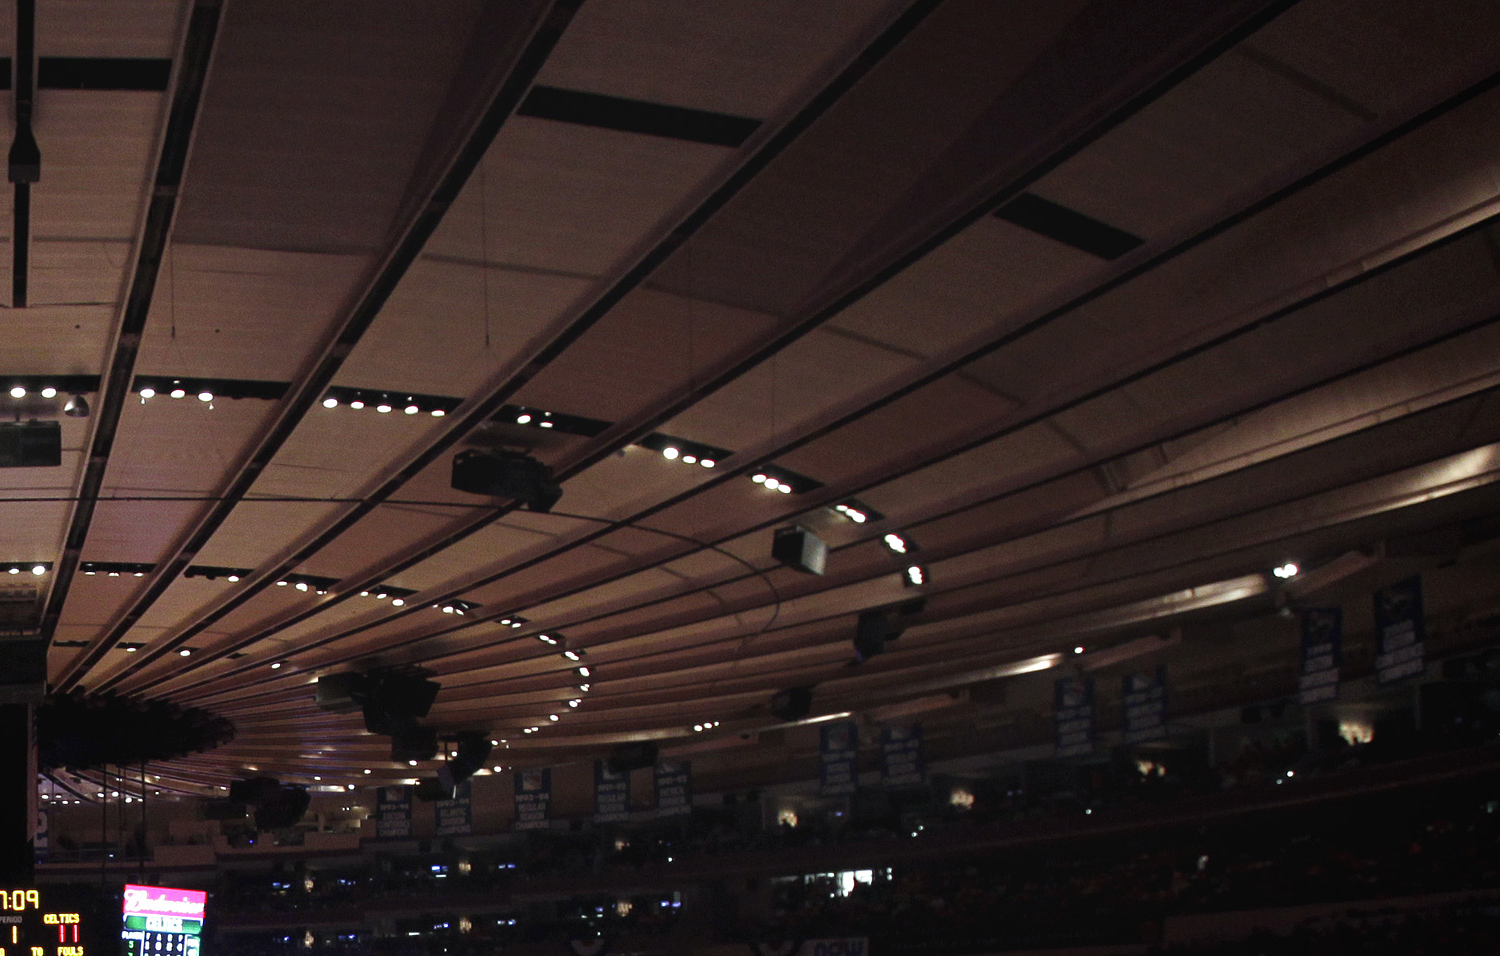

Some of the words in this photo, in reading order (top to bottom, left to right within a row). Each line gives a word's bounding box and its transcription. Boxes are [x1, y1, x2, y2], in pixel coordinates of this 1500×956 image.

[123, 889, 205, 914] Budweiser
[43, 914, 80, 925] CELTICS
[145, 917, 183, 933] CELTICS
[12, 925, 18, 944] 1
[58, 924, 80, 943] 11
[31, 946, 44, 956] TO
[57, 946, 84, 956] FOULS
[128, 940, 134, 949] 5
